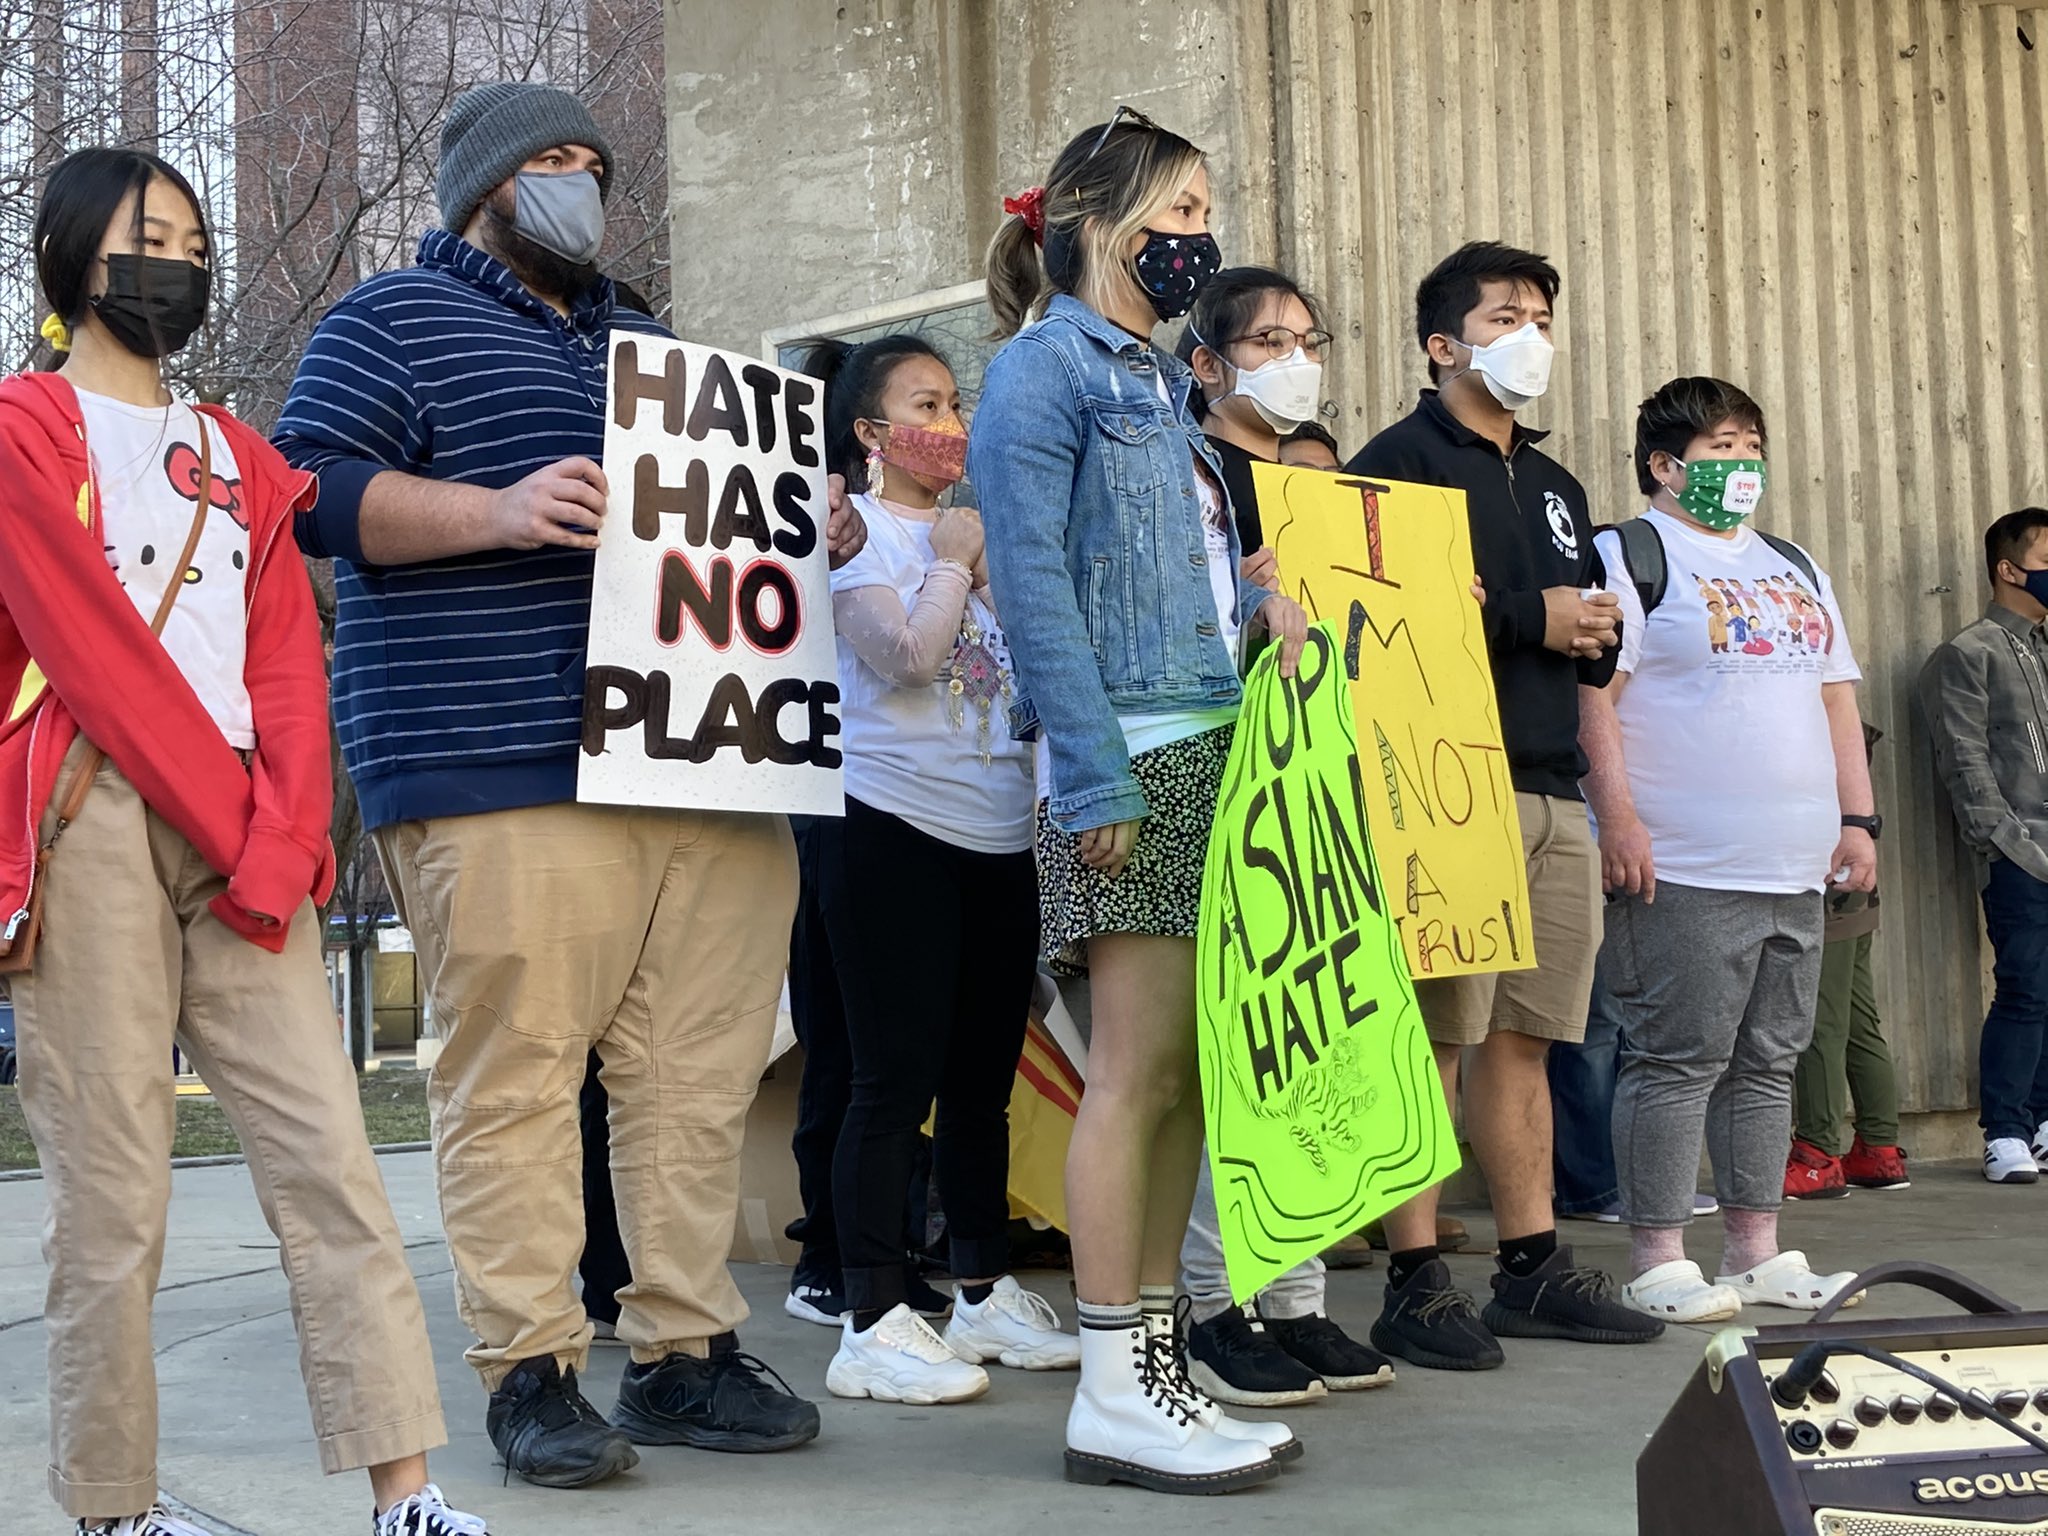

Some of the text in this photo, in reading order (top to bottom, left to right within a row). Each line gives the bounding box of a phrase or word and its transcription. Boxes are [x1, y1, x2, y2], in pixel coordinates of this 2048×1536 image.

[613, 340, 818, 467] HATE
[1294, 394, 1310, 404] 3M
[632, 453, 816, 558] HAS
[1331, 479, 1401, 589] I
[1736, 481, 1755, 491] STOP
[654, 548, 804, 657] NO
[580, 665, 843, 769] PLACE
[1373, 719, 1503, 830] NOT
[1219, 753, 1382, 1003] ASIAN
[1406, 849, 1447, 917] A
[1241, 929, 1379, 1102] HATE
